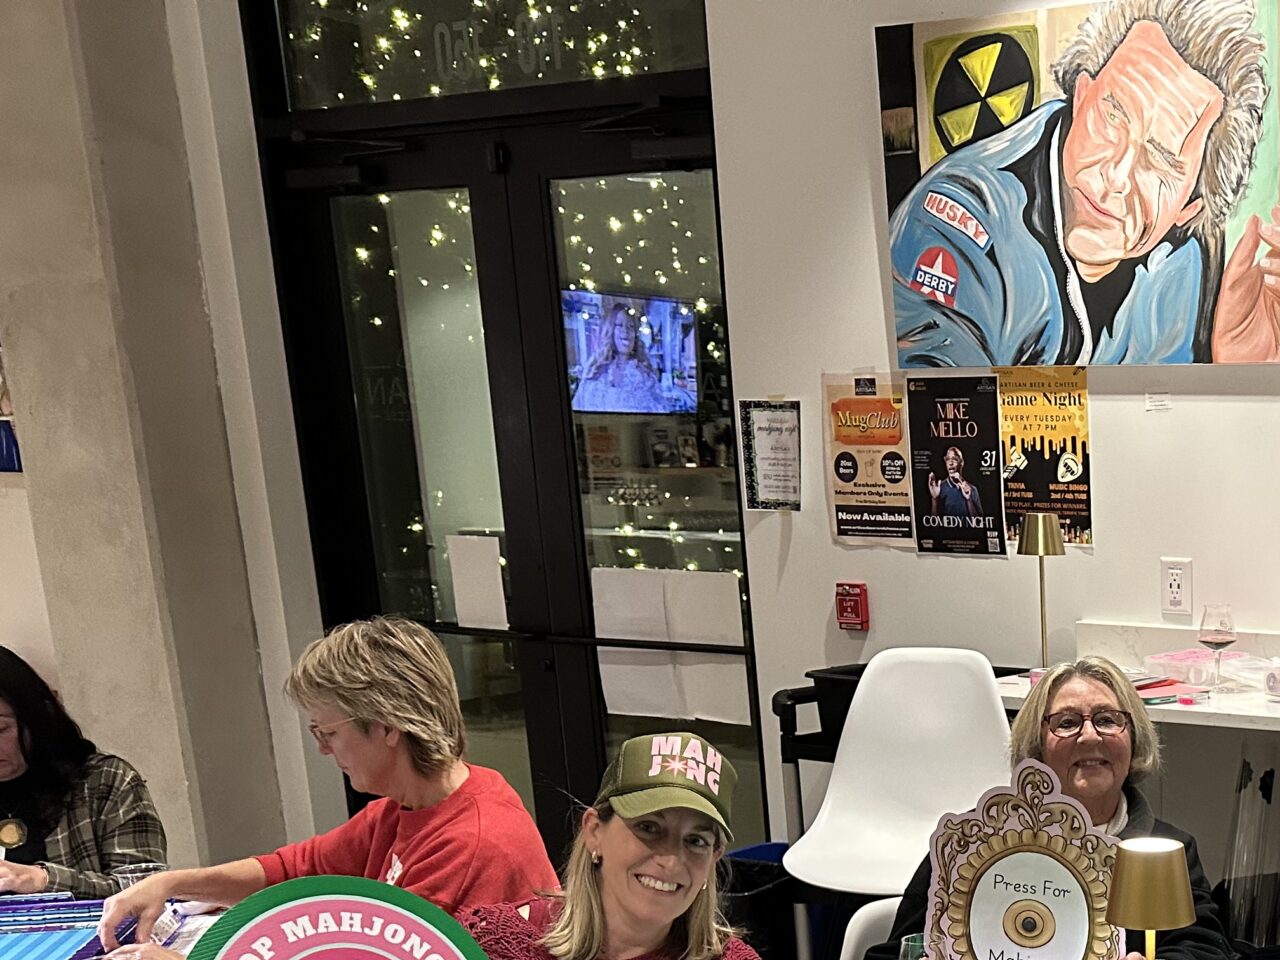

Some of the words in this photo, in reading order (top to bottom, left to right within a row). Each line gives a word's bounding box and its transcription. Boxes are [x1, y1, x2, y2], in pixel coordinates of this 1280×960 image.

[926, 194, 985, 240] HUSKY
[916, 270, 955, 295] DERBY
[1042, 391, 1084, 410] Night
[937, 402, 969, 419] MIKE
[1004, 414, 1030, 422] EVERY
[1034, 414, 1072, 422] TUESDAY
[930, 421, 978, 438] MELLO
[981, 450, 996, 467] 31
[838, 512, 861, 520] Now
[862, 512, 911, 522] Available
[923, 515, 962, 528] COMEDY
[965, 516, 994, 528] NIGHT
[651, 736, 722, 775] MAH
[993, 873, 1037, 894] Press
[1043, 880, 1071, 898] For
